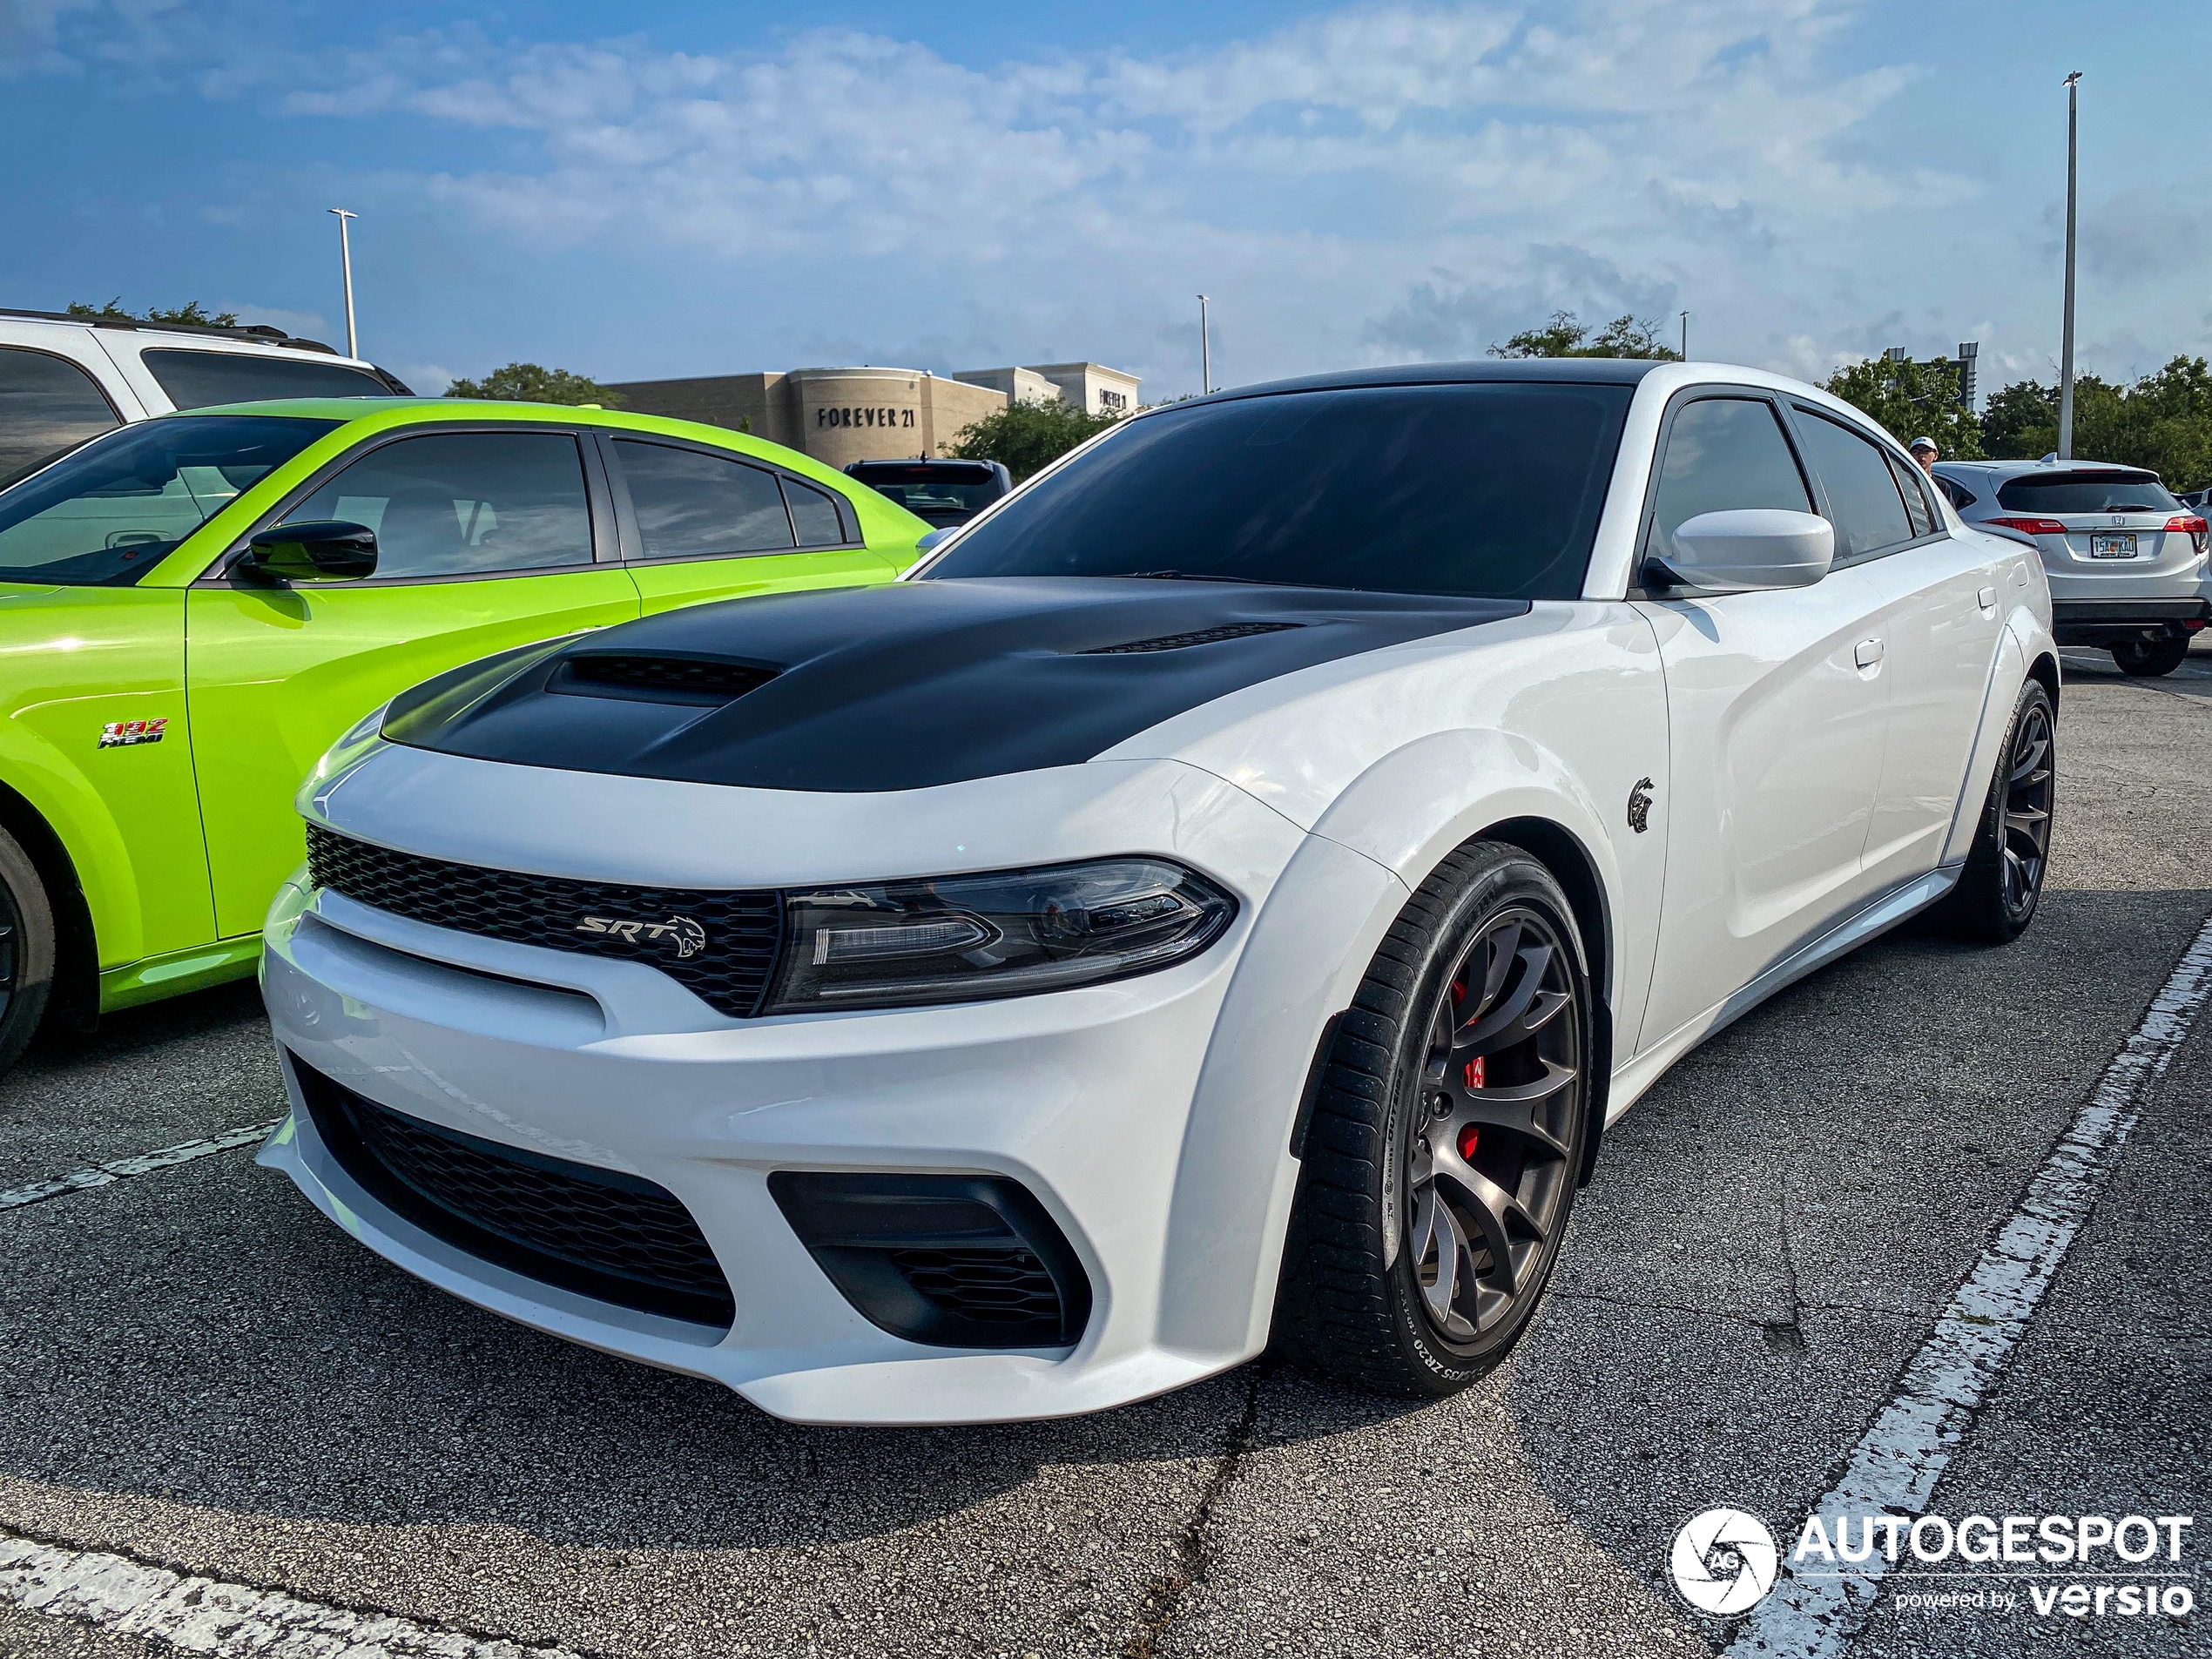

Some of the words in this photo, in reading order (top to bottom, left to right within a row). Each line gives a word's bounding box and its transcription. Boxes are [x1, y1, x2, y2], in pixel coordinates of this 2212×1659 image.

[817, 408, 897, 428] FOREVER
[901, 408, 914, 428] 21
[103, 718, 170, 737] 392
[576, 916, 679, 943] SRT
[1413, 1339, 1445, 1374] ZR20
